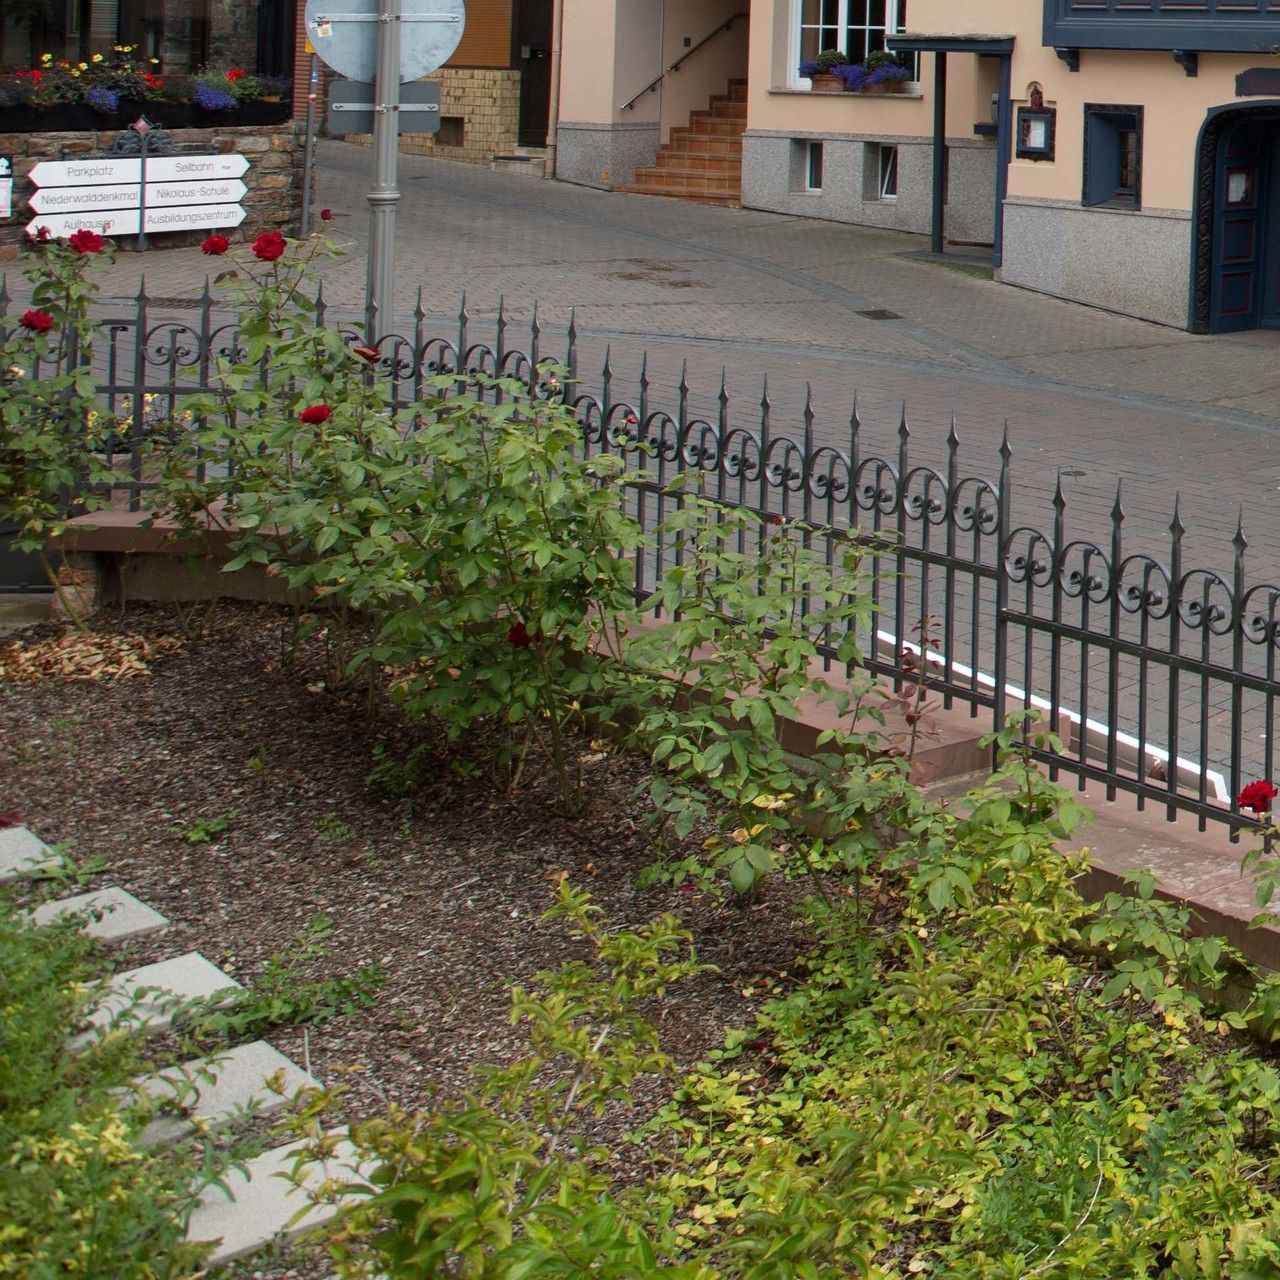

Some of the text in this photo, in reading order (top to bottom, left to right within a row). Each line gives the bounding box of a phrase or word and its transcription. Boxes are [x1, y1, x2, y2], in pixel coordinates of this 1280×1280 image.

[67, 166, 114, 179] Parkplatz
[175, 162, 214, 173] Seilbahn
[41, 190, 138, 205] Niederwalddenkmal
[156, 186, 230, 199] Nikolaus-Schule
[147, 210, 238, 225] Ausbildungszentrum
